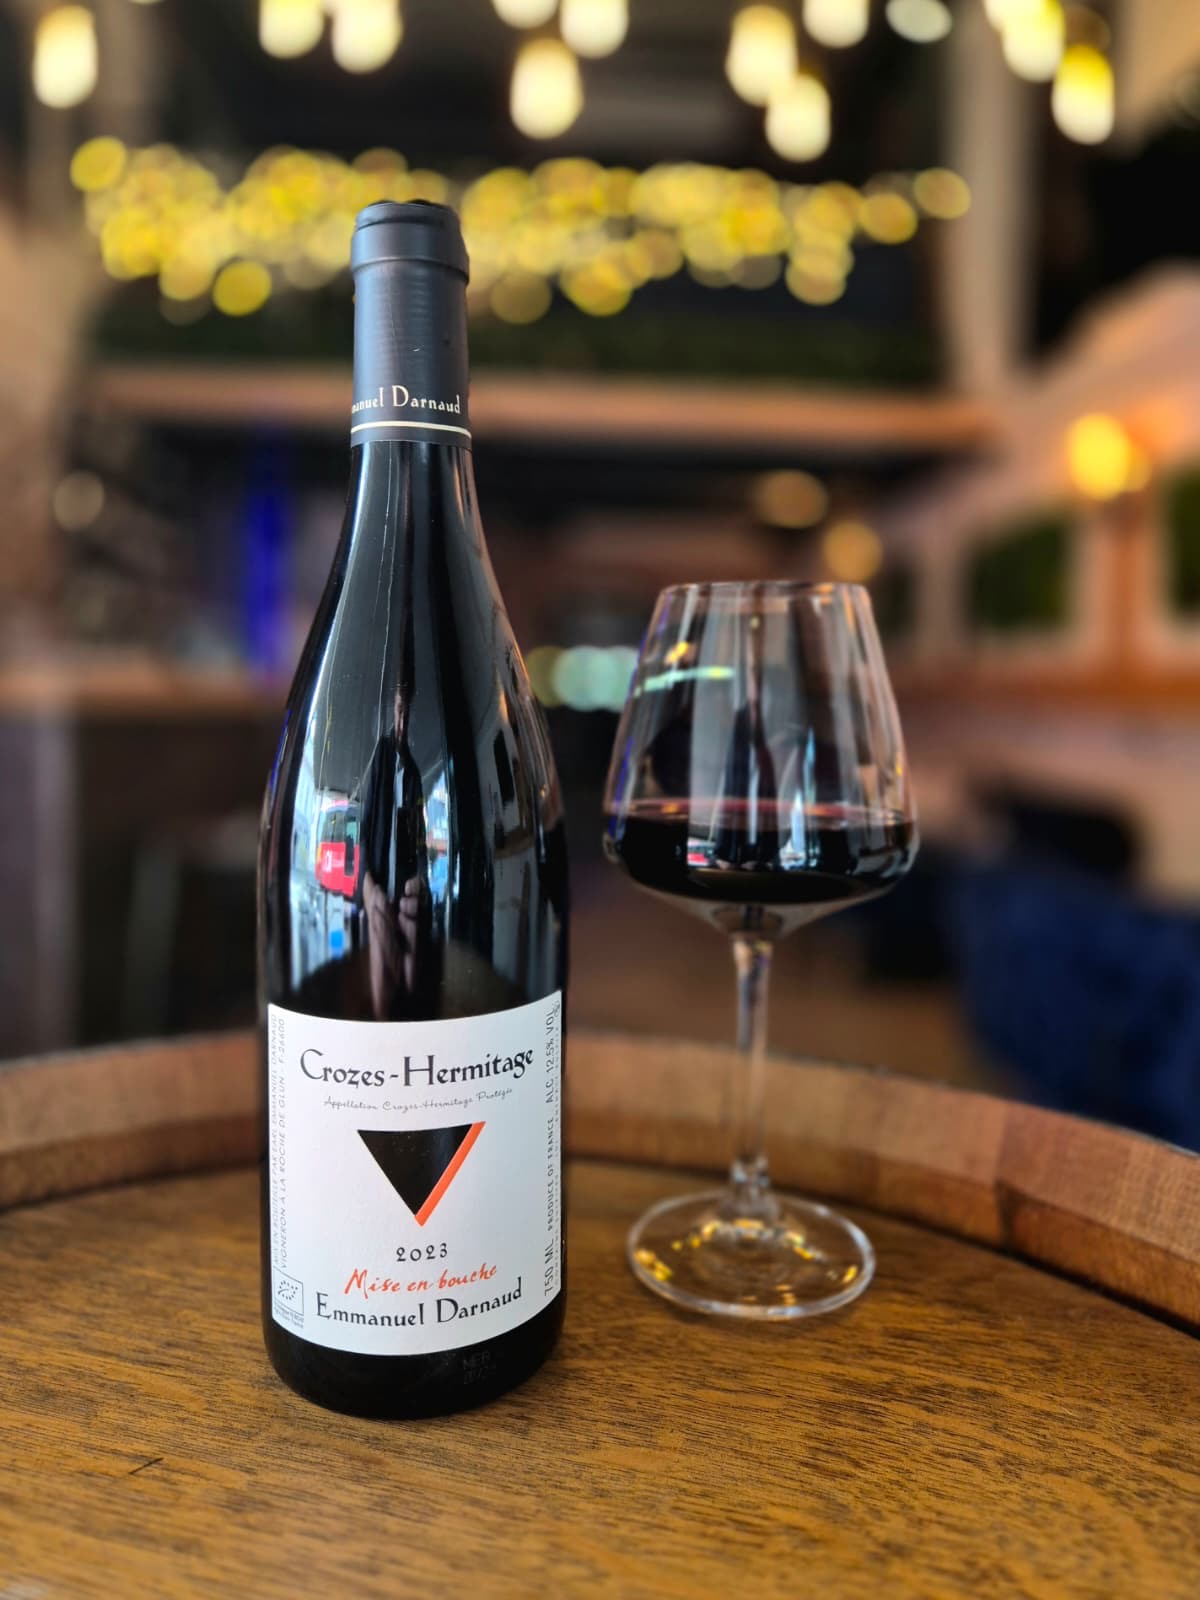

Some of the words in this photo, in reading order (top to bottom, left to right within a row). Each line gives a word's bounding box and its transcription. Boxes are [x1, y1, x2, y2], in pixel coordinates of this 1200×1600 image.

[391, 384, 461, 414] Darnaud
[299, 1047, 534, 1089] Crozes-Hermitage
[278, 1111, 286, 1129] DE
[279, 1178, 286, 1193] LA
[547, 1164, 554, 1177] OF
[546, 1179, 554, 1232] PRODUCE
[279, 1207, 288, 1269] VIGNERON
[396, 1242, 449, 1262] 2023
[544, 1238, 554, 1265] ML
[344, 1267, 400, 1300] Mise
[406, 1278, 430, 1292] en
[438, 1262, 498, 1290] bouche
[544, 1266, 554, 1297] 750
[315, 1291, 425, 1327] Emmanuel
[436, 1276, 523, 1324] Darnaud
